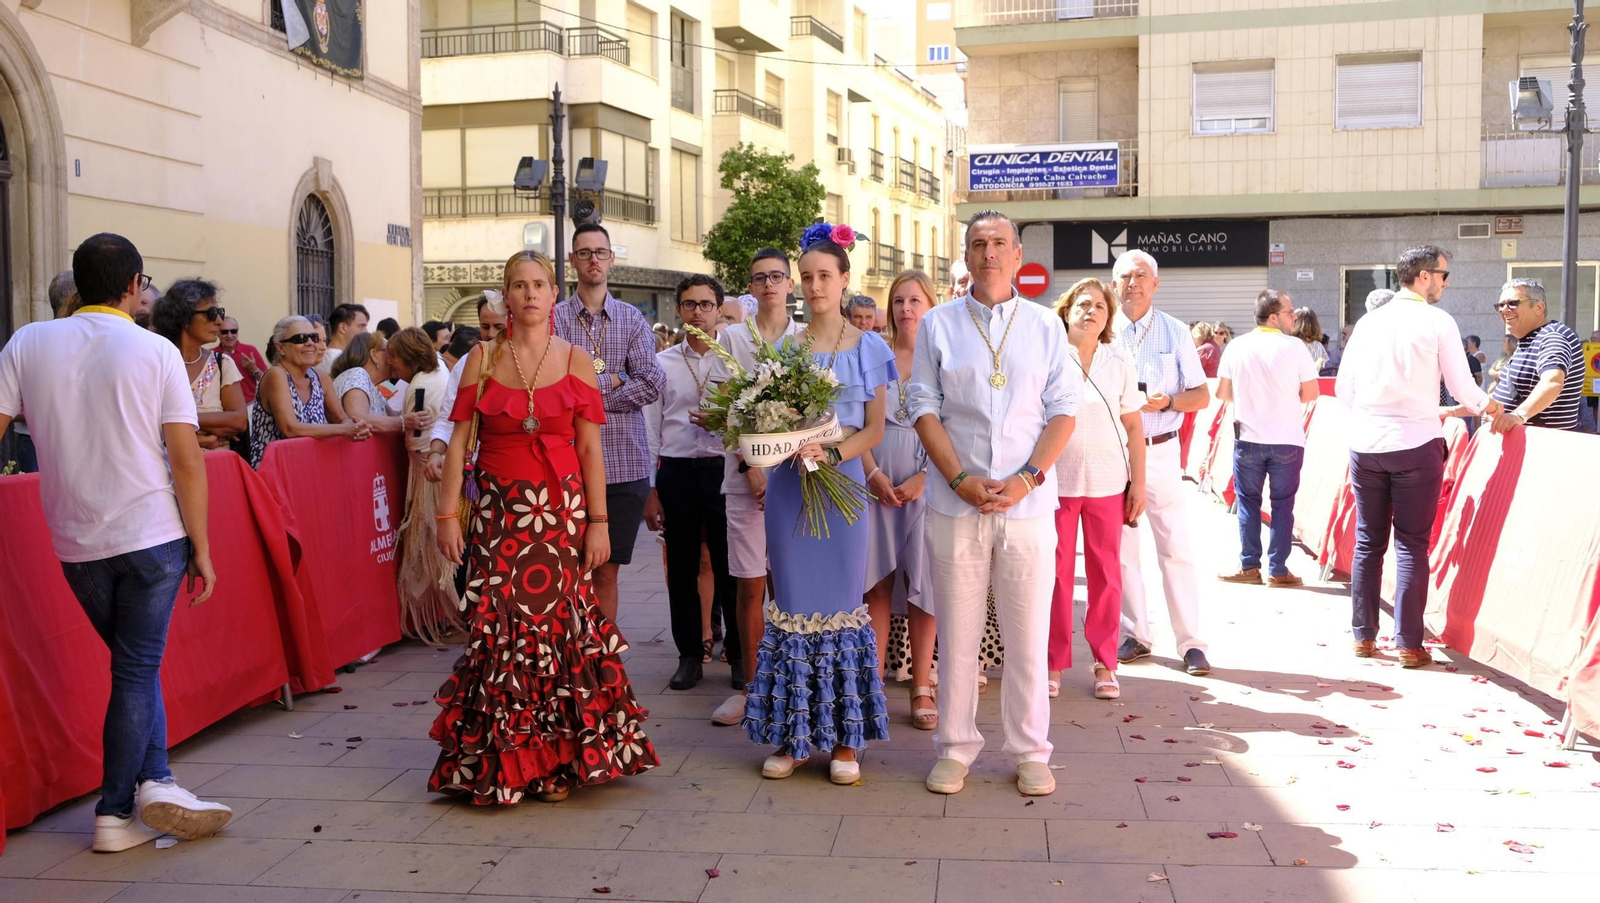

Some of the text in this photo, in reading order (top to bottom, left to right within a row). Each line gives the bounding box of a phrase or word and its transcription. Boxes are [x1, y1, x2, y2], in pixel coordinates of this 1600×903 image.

[974, 150, 1114, 166] CLINICA DENTAL
[1006, 166, 1047, 175] Implantes
[1089, 164, 1117, 172] Dental
[997, 175, 1040, 184] Alejandro
[1043, 174, 1066, 182] Caba
[1068, 173, 1107, 181] Calvache
[973, 182, 1025, 190] ORTODONCIA
[1137, 232, 1228, 245] MAÑAS CANO
[751, 441, 795, 456] HDAD.
